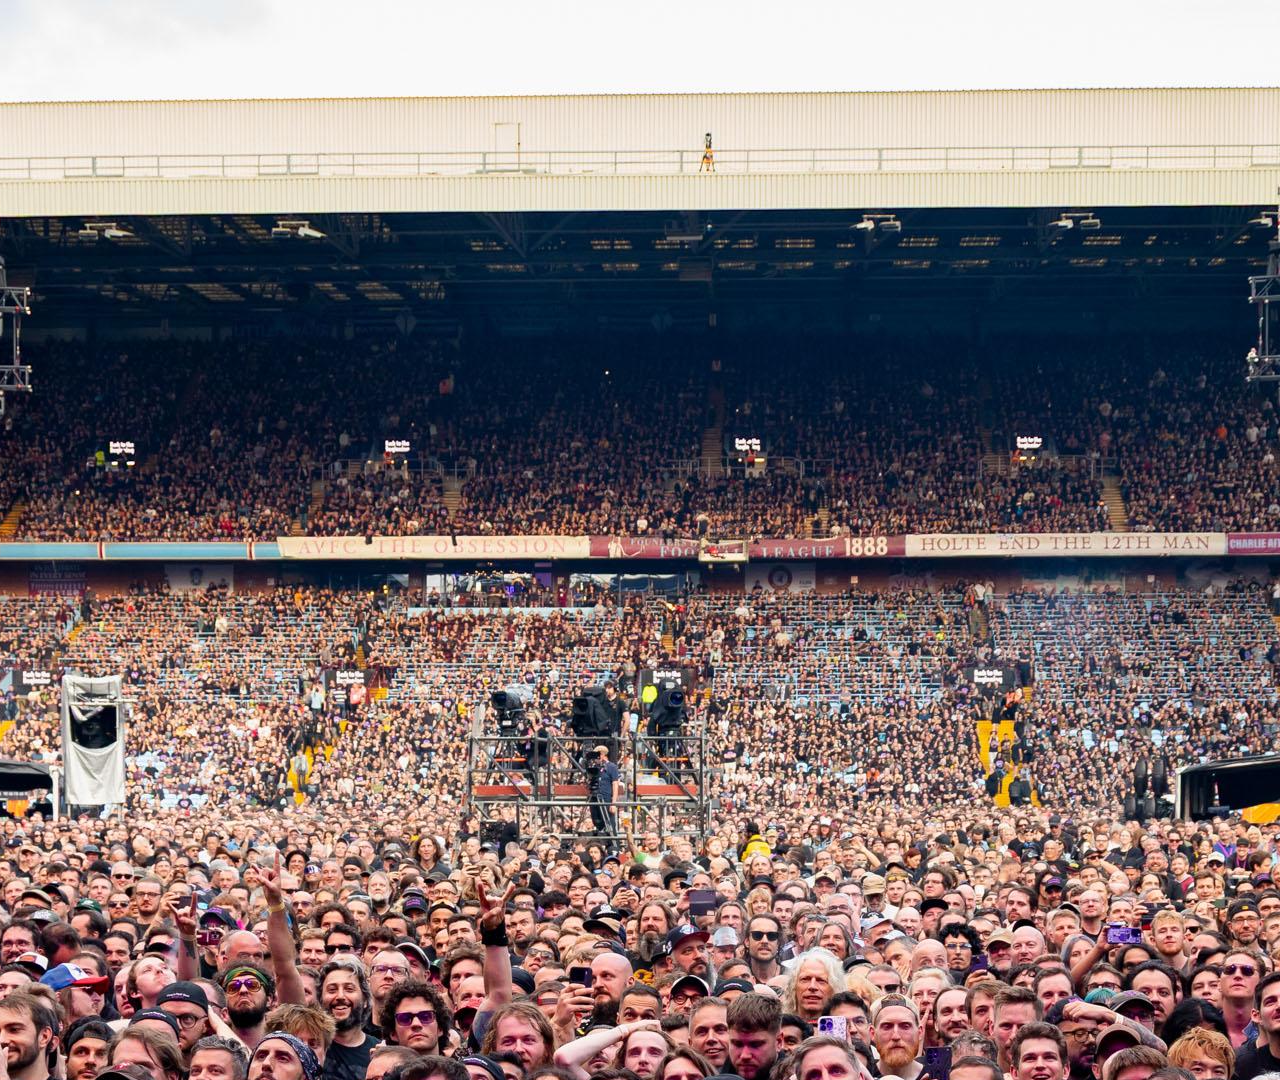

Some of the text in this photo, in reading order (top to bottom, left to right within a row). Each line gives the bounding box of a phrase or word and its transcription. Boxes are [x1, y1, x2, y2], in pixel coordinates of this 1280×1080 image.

[298, 540, 358, 554] AVFC
[434, 538, 566, 554] OBSESSION
[844, 537, 888, 556] 1888
[920, 535, 1211, 551] HOLTE END THE 12TH MAN
[1229, 538, 1267, 549] CHARLIE
